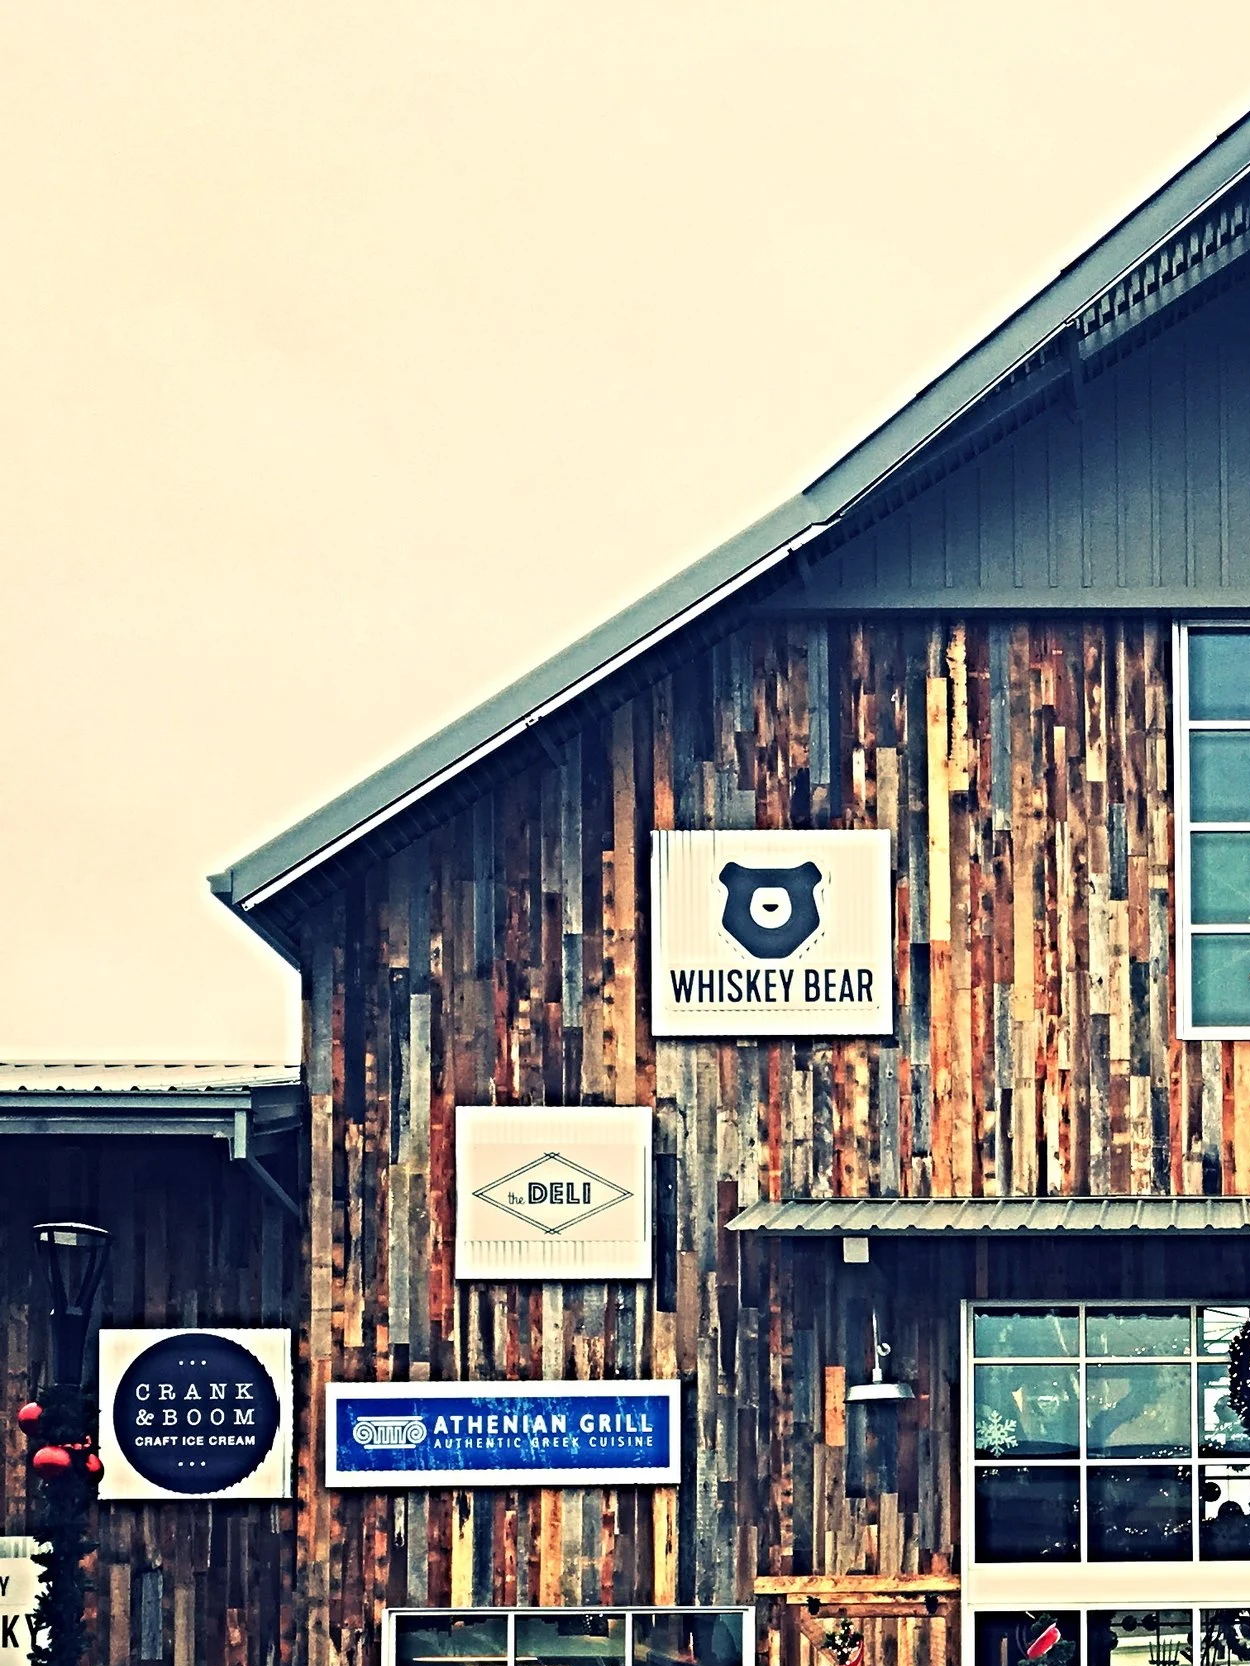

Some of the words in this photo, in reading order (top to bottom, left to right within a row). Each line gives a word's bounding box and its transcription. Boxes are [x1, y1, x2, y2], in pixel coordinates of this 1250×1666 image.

[669, 968, 795, 1003] WHISKEY
[804, 968, 873, 1003] BEAR
[508, 1192, 525, 1205] the
[528, 1182, 591, 1204] DELI
[135, 1383, 254, 1401] CRANK
[162, 1408, 255, 1426] BOOM
[433, 1415, 566, 1435] ATHENIAN
[579, 1414, 653, 1434] GRILL
[134, 1436, 178, 1447] CRAFT
[182, 1436, 204, 1446] ICE
[208, 1436, 256, 1446] CREAM
[433, 1437, 521, 1449] AUTHENTIC
[530, 1436, 580, 1448] GREEK
[589, 1436, 654, 1448] CUISINE
